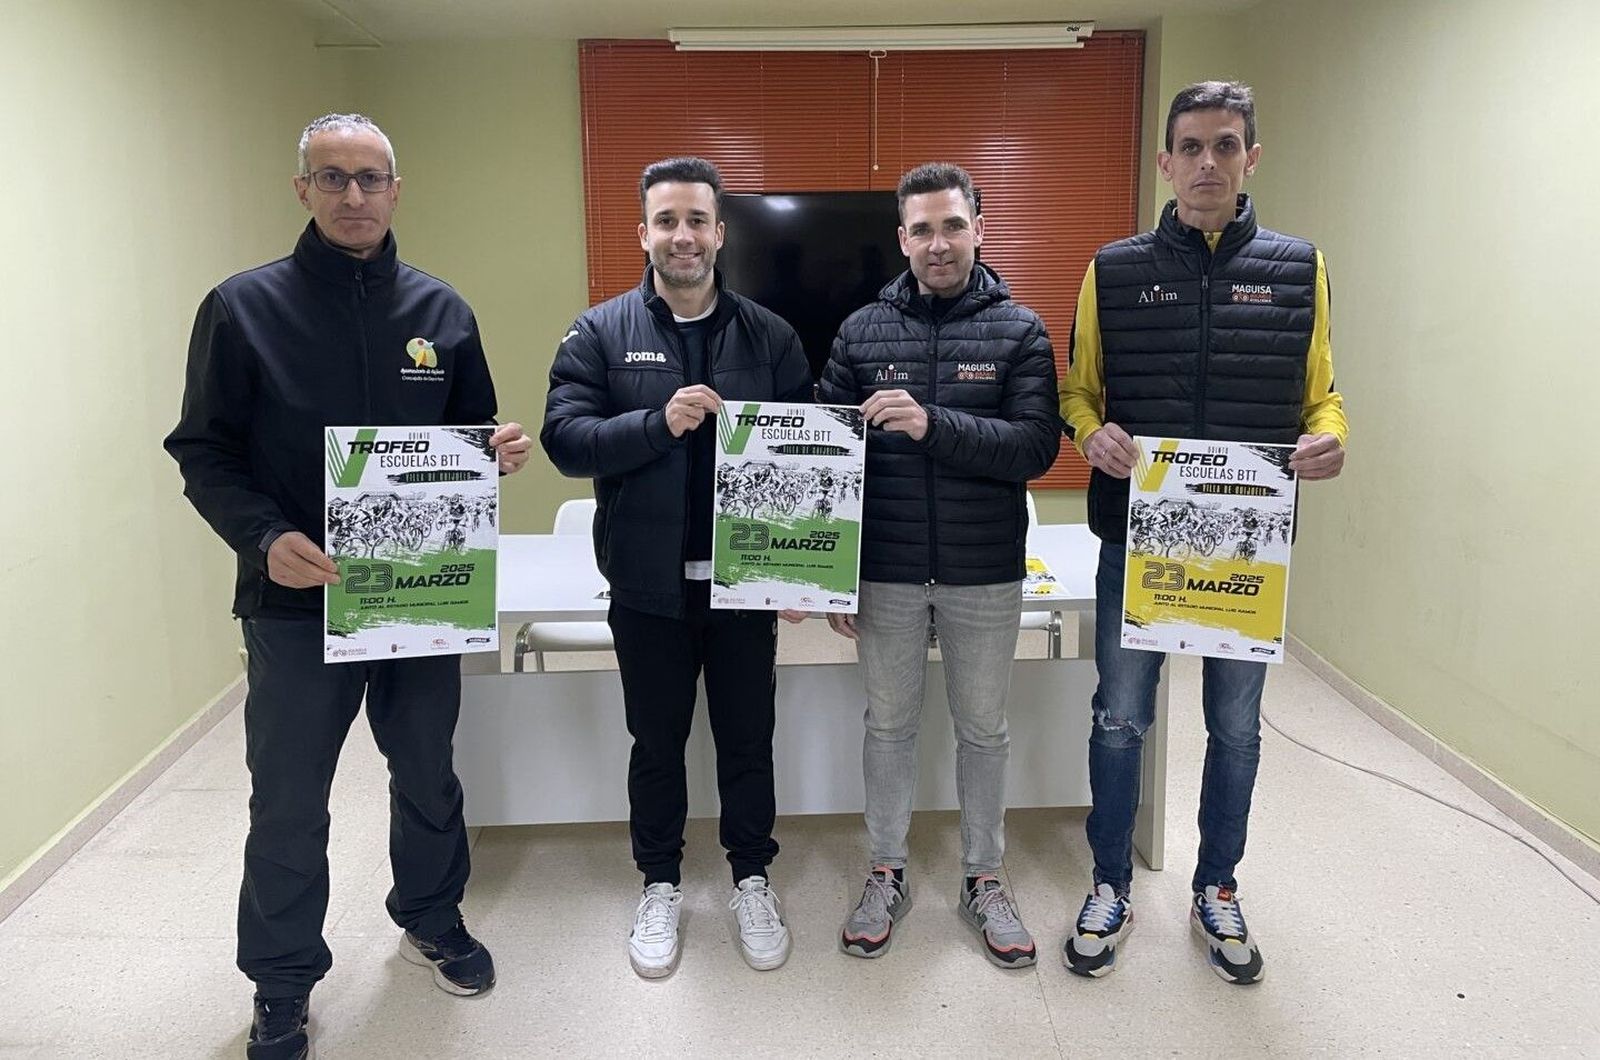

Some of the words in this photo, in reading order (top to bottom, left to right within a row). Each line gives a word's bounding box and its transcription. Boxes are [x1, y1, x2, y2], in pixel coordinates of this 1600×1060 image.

[1231, 284, 1272, 294] MAGUISA
[958, 363, 996, 372] MAGUISA
[735, 414, 805, 428] TROFEO
[761, 428, 811, 441] ESCUELAS
[813, 430, 832, 442] BTT
[347, 440, 430, 454] TROFEO
[380, 454, 437, 468] ESCUELAS
[441, 453, 461, 467] BTT
[1151, 450, 1228, 467] TROFEO
[1179, 465, 1234, 480] ESCUELAS
[1237, 469, 1258, 482] BTT
[729, 522, 770, 551] 23
[770, 537, 836, 552] MARZO
[809, 530, 841, 540] 2025
[440, 563, 475, 573] 2025
[345, 563, 393, 594] 23
[395, 572, 471, 590] MARZO
[1142, 560, 1186, 592] 23
[1186, 578, 1260, 597] MARZO
[1230, 573, 1265, 584] 2025
